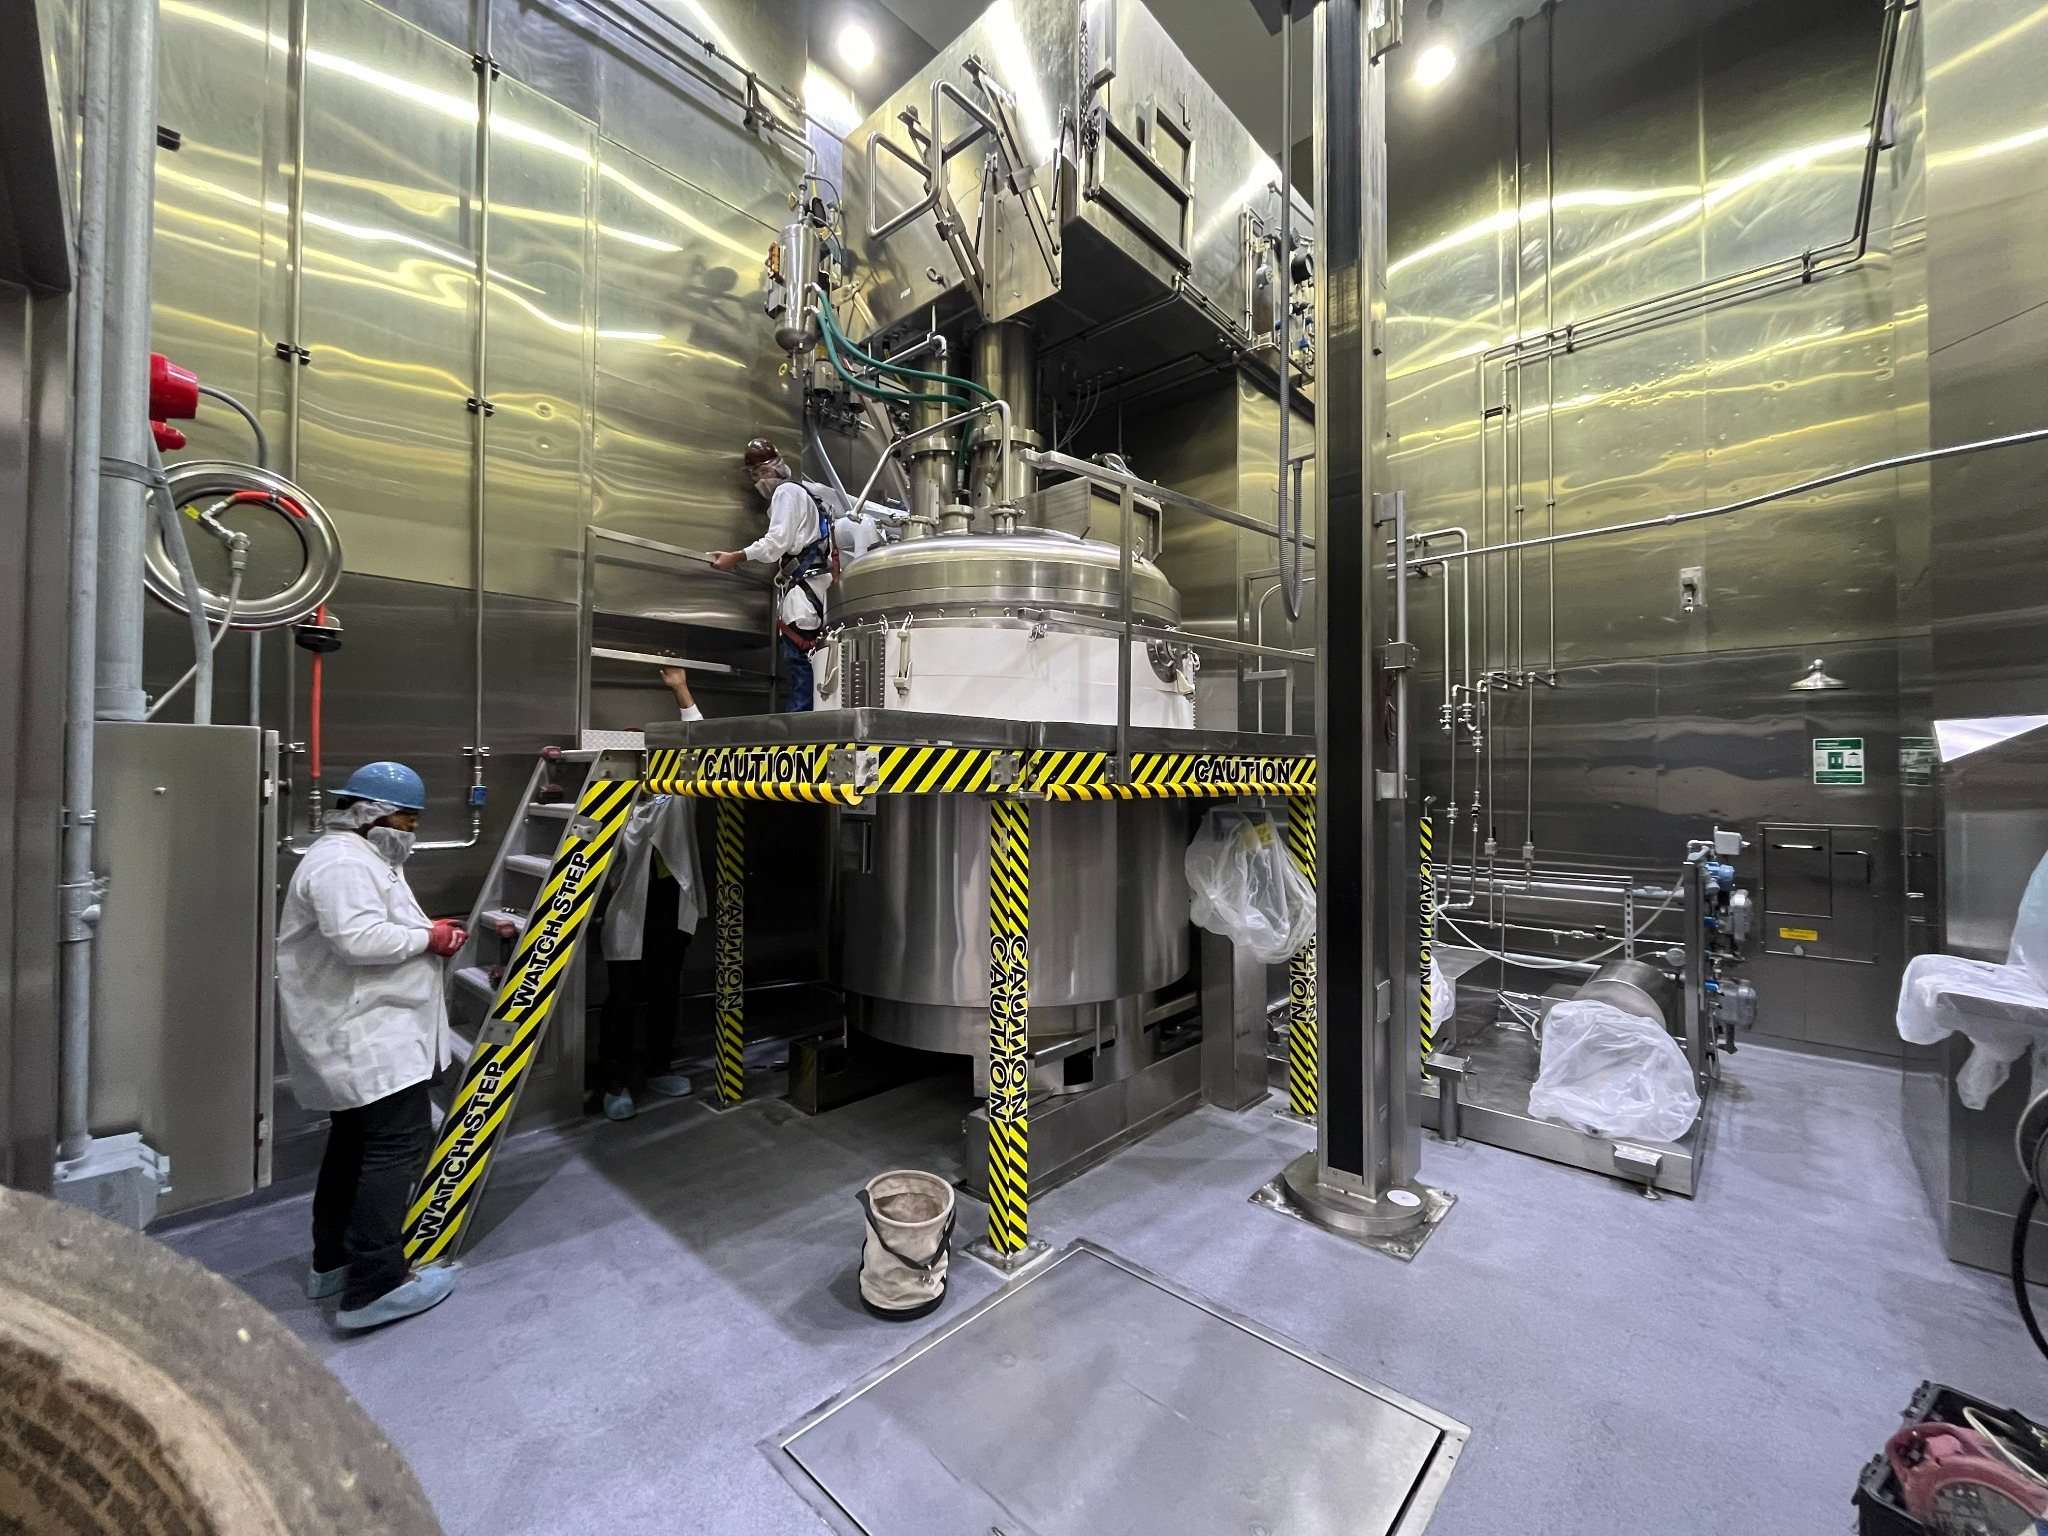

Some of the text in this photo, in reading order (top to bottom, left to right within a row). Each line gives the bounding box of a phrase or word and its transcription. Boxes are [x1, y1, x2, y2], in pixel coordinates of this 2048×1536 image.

[703, 750, 815, 782] CAUTION
[1194, 758, 1290, 783] CAUTION
[510, 851, 590, 1008] WATCH STEP
[727, 883, 743, 1010] CAUTION
[1291, 952, 1307, 1021] TION
[1419, 862, 1432, 986] CAUTION
[990, 935, 1008, 1122] CAUTION
[1010, 935, 1028, 1122] CAUTION
[415, 1060, 505, 1240] WATCH STEP
